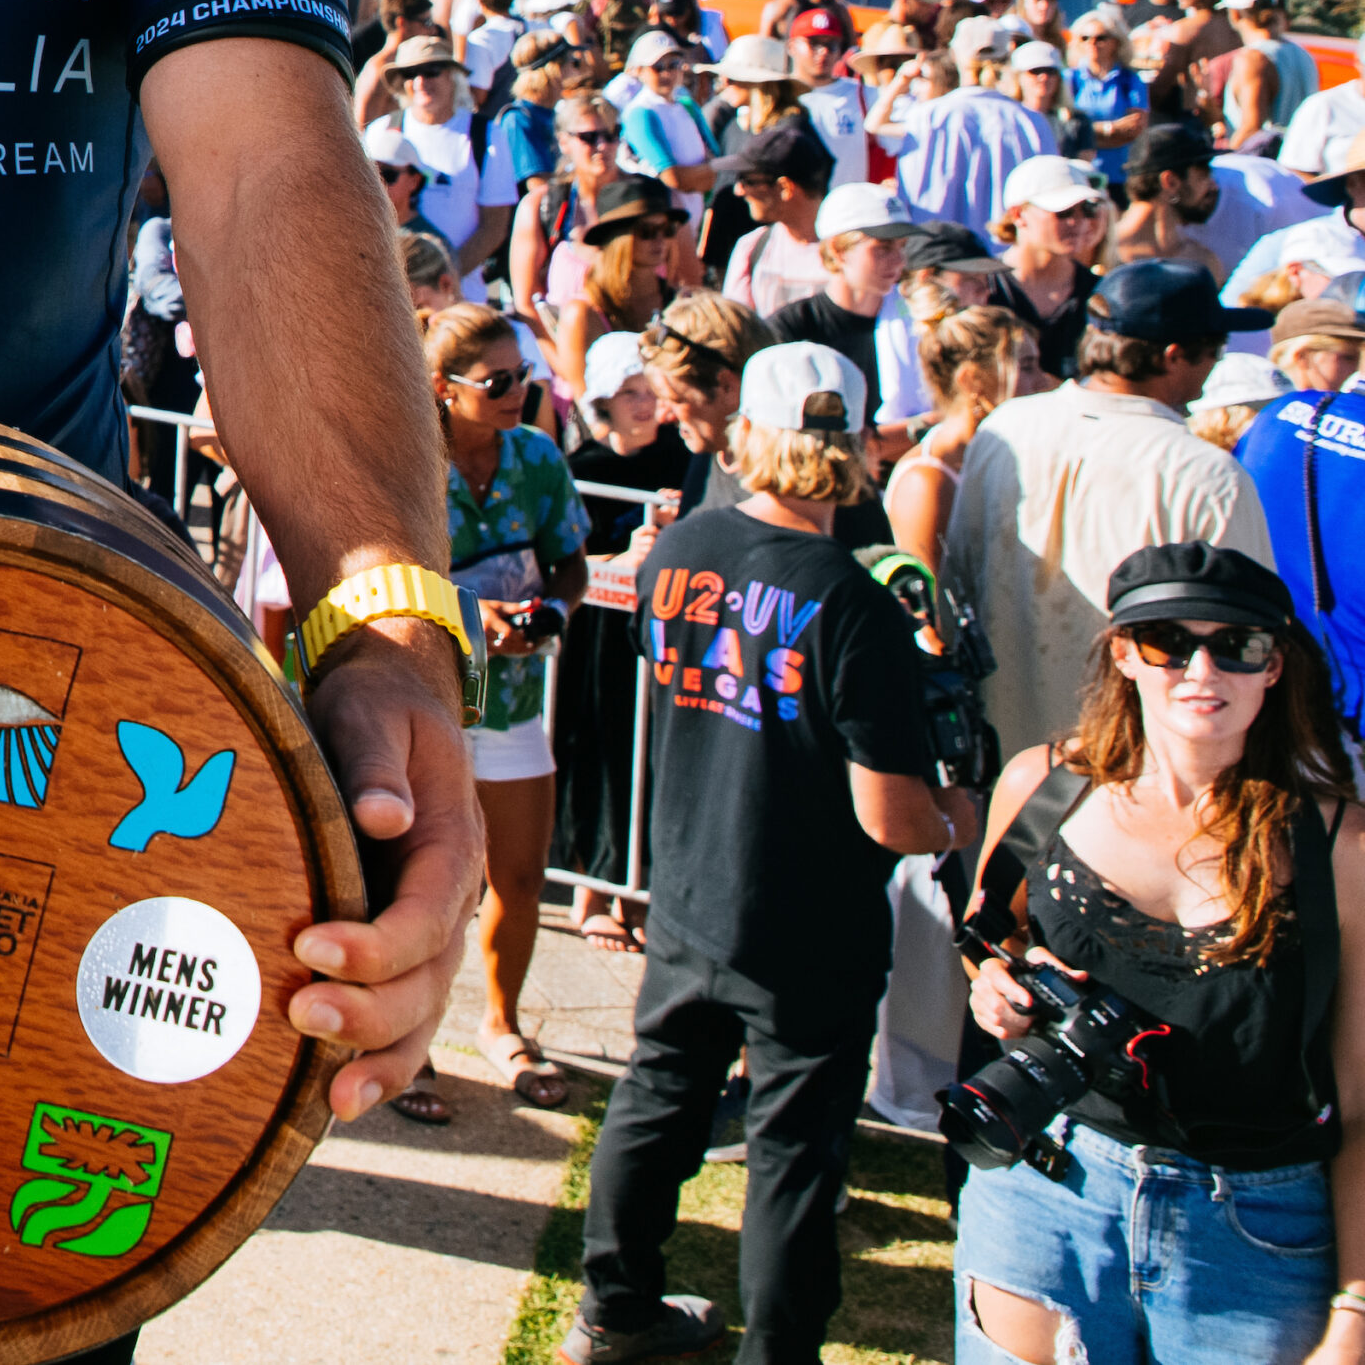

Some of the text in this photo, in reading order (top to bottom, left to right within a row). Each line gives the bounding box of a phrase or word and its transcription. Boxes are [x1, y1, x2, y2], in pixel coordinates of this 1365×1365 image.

[135, 9, 186, 54] 2024
[651, 568, 725, 626] U2
[650, 618, 805, 694] LAS
[654, 662, 800, 721] VEGAS
[128, 942, 218, 992] MENS
[102, 975, 227, 1036] WINNER
